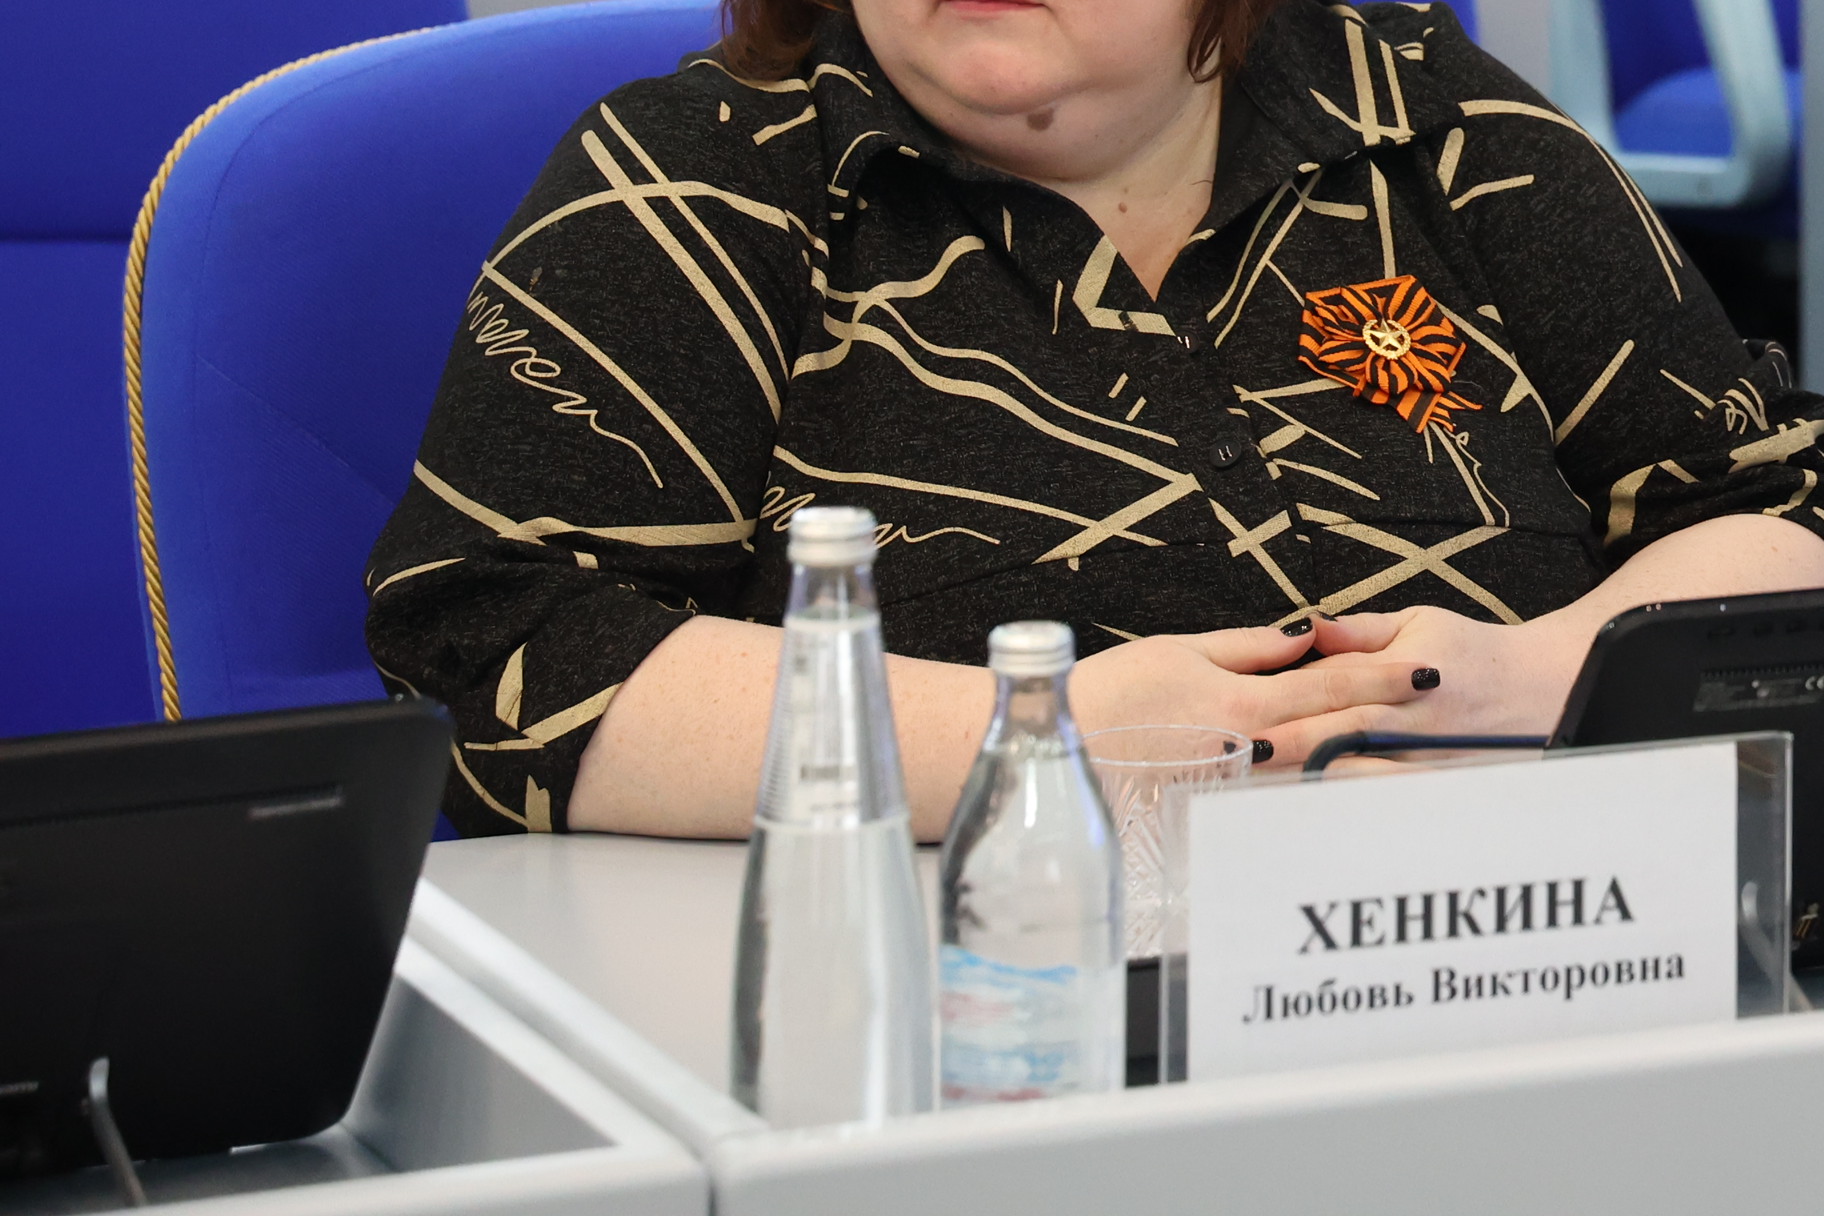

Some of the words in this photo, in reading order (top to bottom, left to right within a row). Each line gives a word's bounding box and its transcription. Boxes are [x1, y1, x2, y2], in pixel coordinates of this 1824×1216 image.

[1296, 875, 1636, 955] ХЕНКИНА
[1241, 977, 1415, 1026] Любовь
[1430, 952, 1686, 1006] Викторовна
